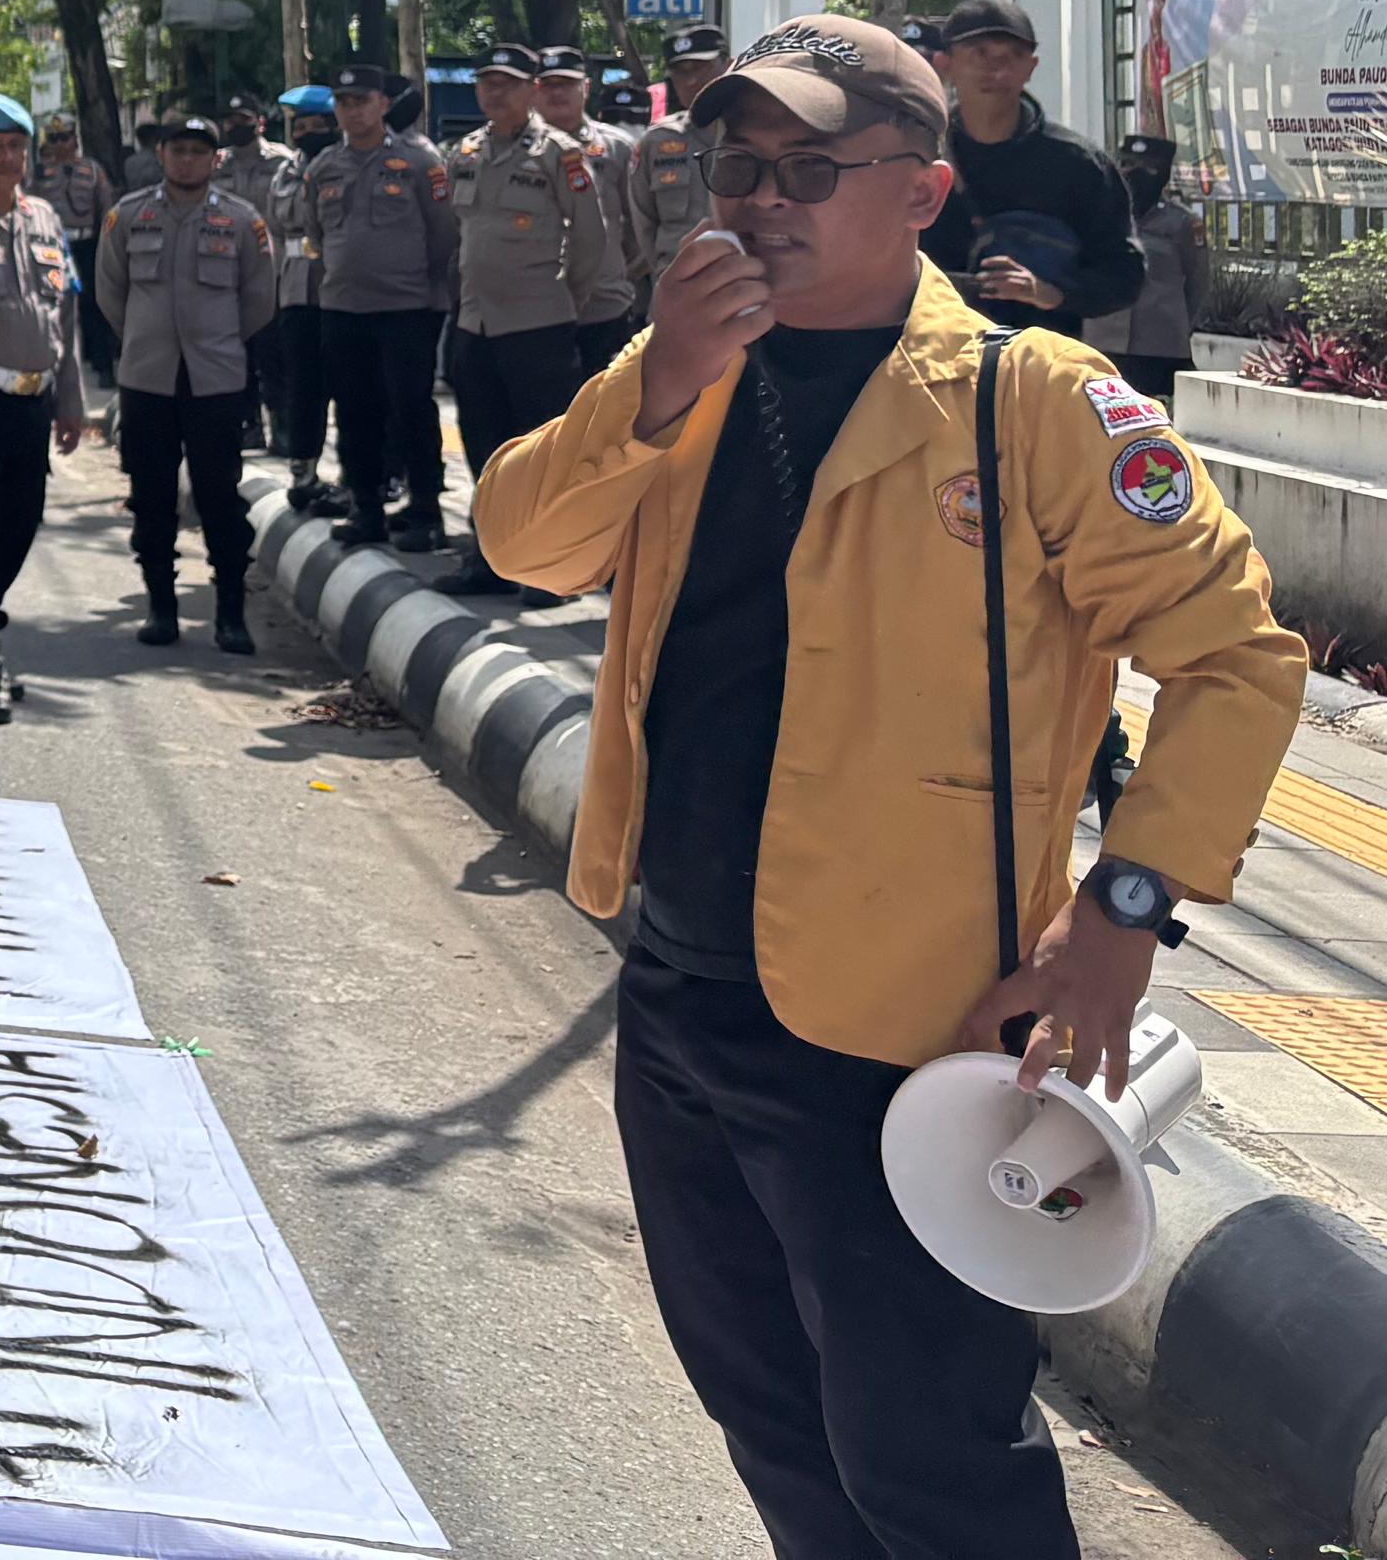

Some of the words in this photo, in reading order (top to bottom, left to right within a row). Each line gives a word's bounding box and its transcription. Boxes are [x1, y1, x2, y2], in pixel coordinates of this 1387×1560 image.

[1320, 67, 1357, 85] BUNDA
[1358, 66, 1387, 85] PAUD
[1267, 117, 1308, 133] SEBAGAI
[1308, 118, 1342, 133] BUNDA
